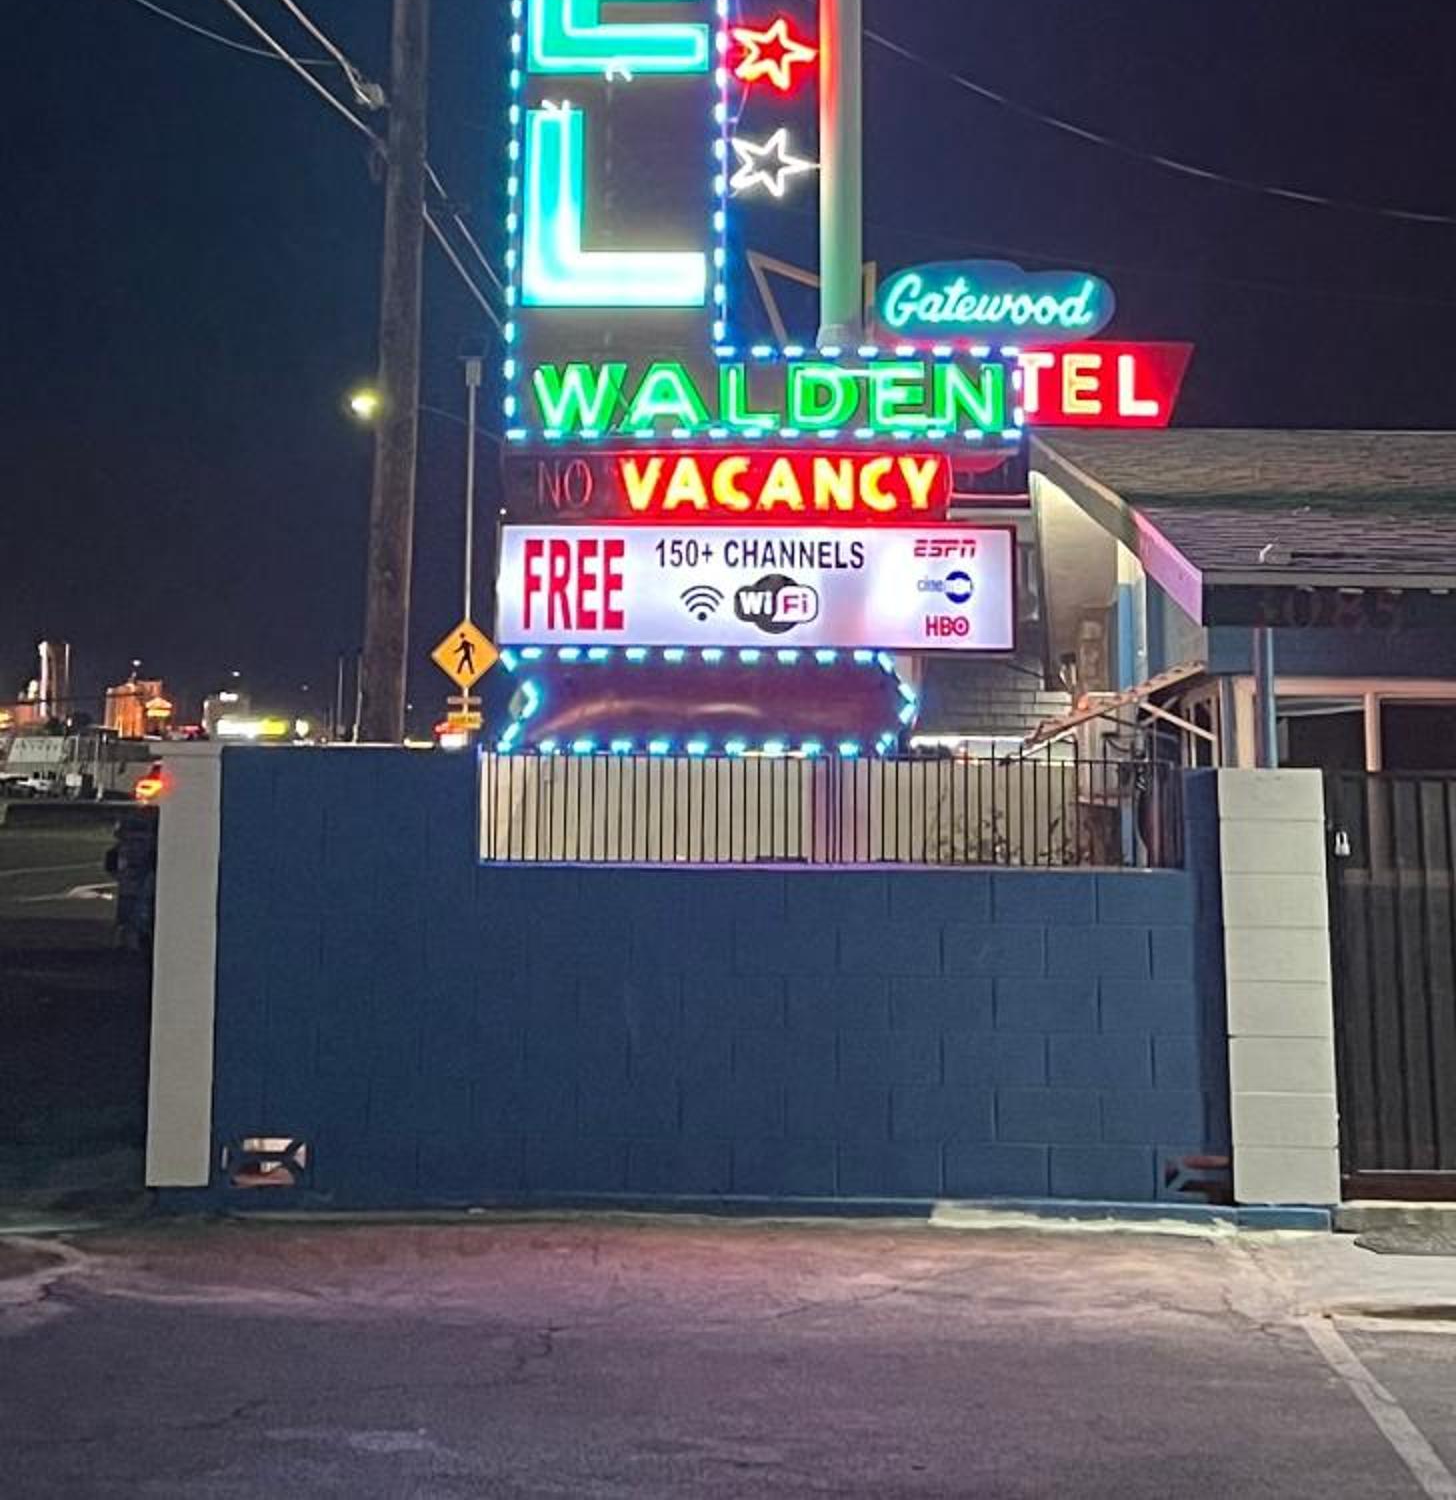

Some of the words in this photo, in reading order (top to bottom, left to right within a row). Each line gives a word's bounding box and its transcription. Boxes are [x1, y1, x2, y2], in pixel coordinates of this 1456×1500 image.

[884, 273, 1095, 327] Gatewood
[533, 361, 1005, 434] WALDEN
[1017, 352, 1159, 416] TEL
[538, 458, 593, 507] NO
[618, 455, 942, 511] VACANCY
[655, 538, 713, 569] 150+
[724, 539, 866, 570] CHANNELS
[913, 539, 977, 558] ESPN
[522, 538, 626, 631] FREE
[925, 615, 970, 637] HBO
